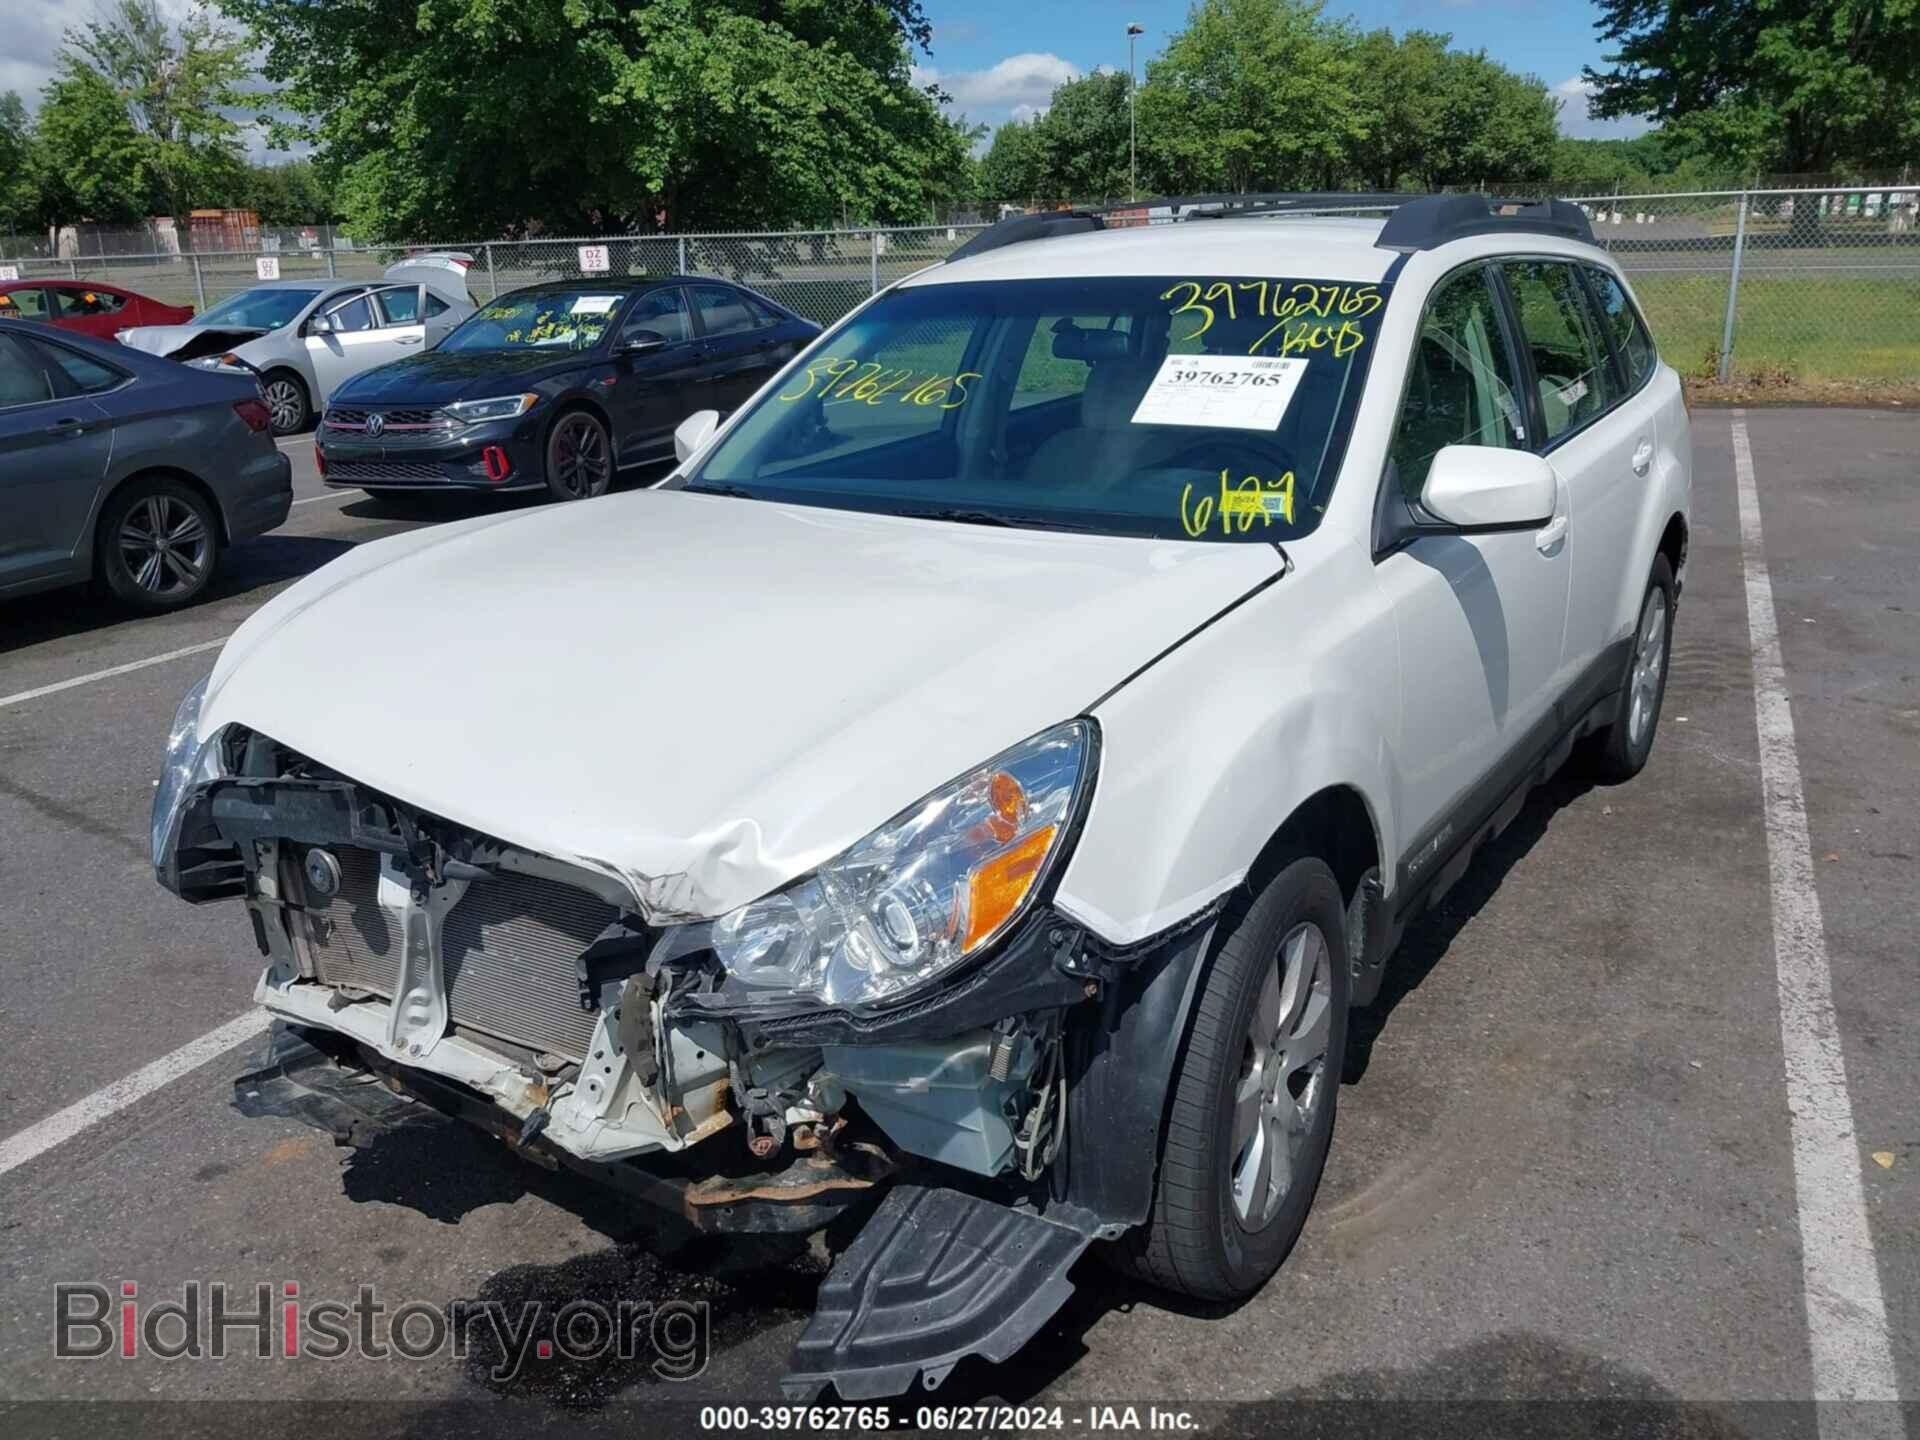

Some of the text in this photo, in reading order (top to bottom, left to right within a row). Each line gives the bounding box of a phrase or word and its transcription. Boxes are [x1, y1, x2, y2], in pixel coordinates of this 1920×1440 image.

[1160, 281, 1383, 341] 39762765
[1168, 370, 1282, 388] 39762765
[1181, 468, 1296, 537] 6/27
